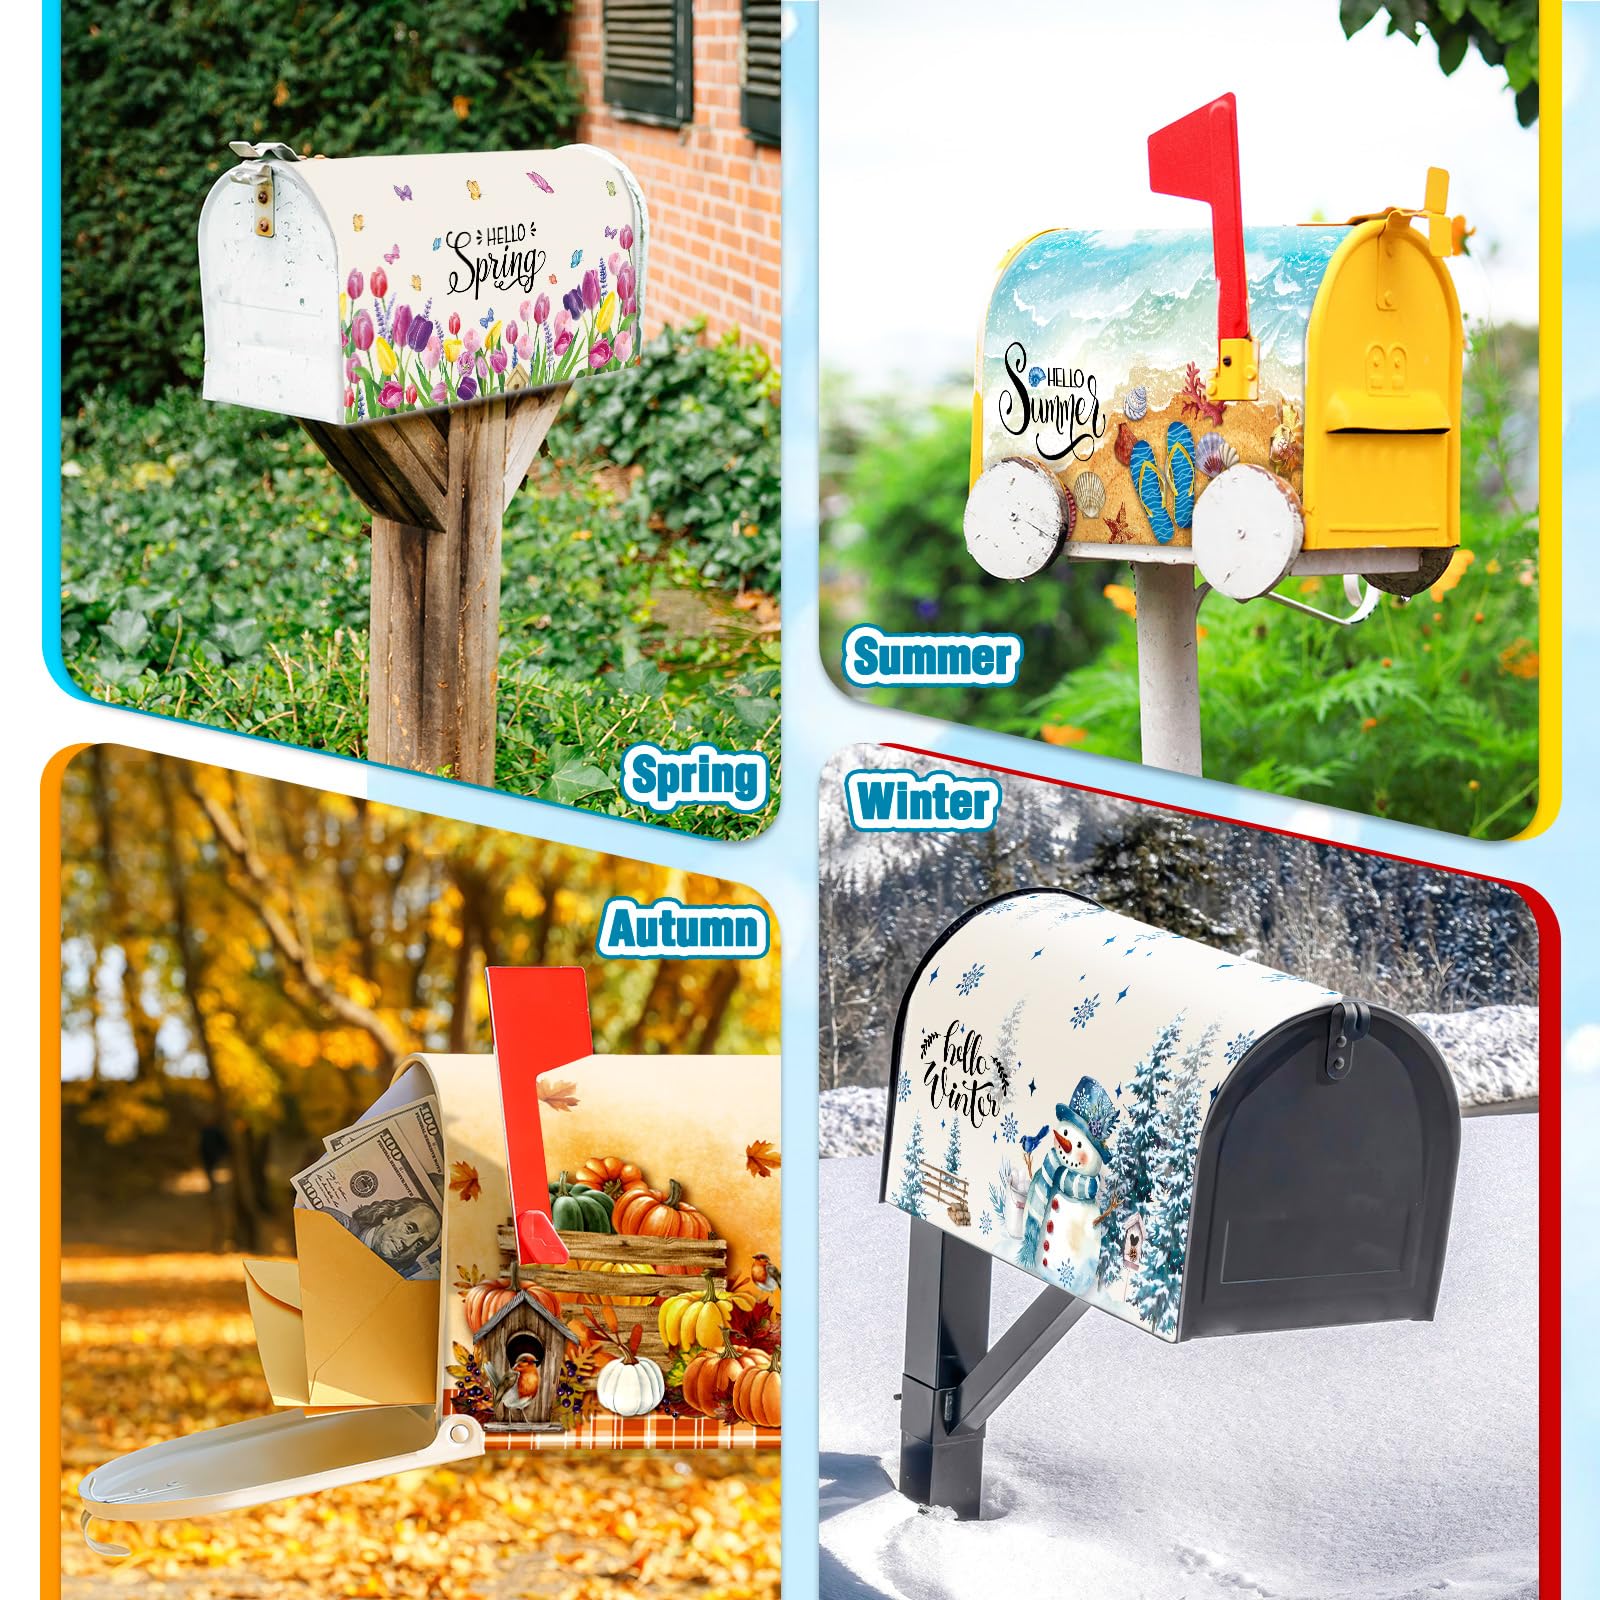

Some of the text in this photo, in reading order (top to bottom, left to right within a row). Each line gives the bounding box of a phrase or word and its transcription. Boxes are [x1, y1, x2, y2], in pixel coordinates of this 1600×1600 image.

[487, 223, 526, 246] HELLO
[445, 231, 547, 300] Spring
[1047, 367, 1085, 388] HELLO
[998, 341, 1106, 462] Summer
[943, 1019, 990, 1076] hello
[923, 1060, 1000, 1128] Winter
[419, 1104, 438, 1136] 100
[380, 1131, 402, 1161] 100
[302, 1180, 324, 1210] 100
